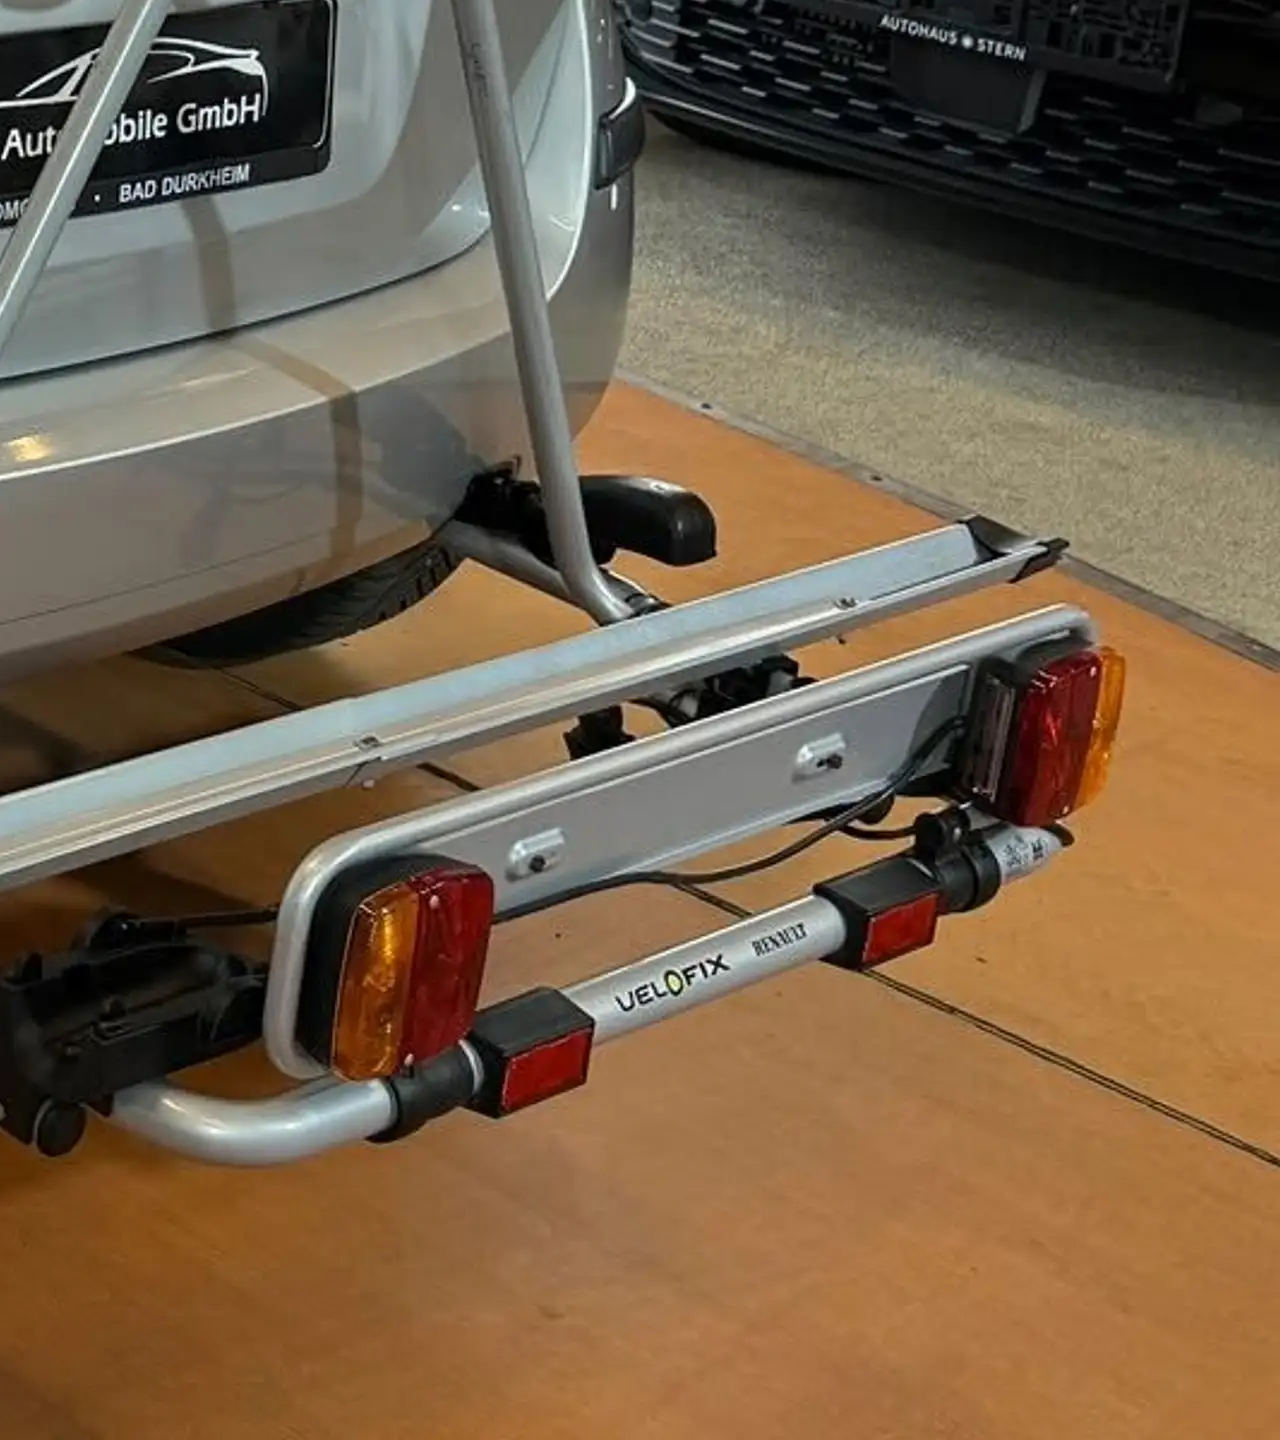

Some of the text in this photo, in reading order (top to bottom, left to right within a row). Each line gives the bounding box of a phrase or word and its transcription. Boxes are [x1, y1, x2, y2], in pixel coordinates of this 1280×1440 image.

[878, 14, 1028, 62] AUTOHAUS STERN
[1, 106, 169, 162] Autobile
[176, 92, 263, 135] GmbH
[119, 179, 157, 203] BAD
[751, 921, 809, 957] RENAULT
[614, 952, 732, 1013] VELOFIX
